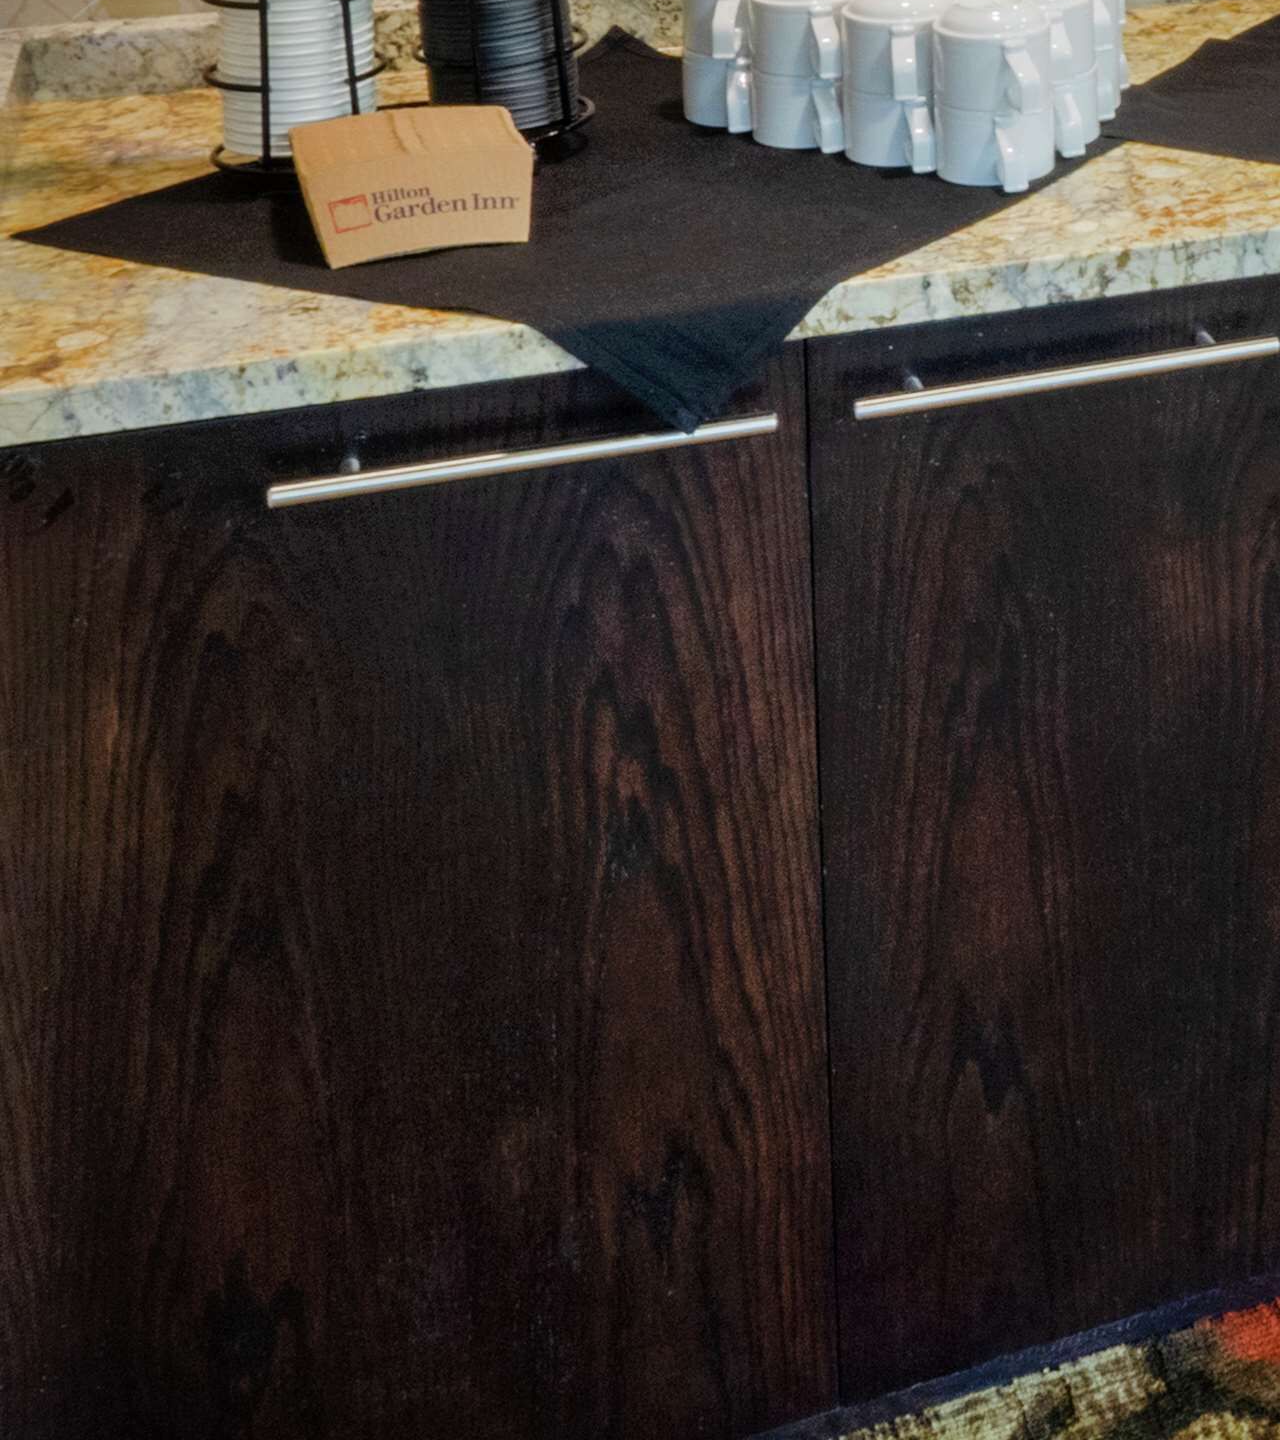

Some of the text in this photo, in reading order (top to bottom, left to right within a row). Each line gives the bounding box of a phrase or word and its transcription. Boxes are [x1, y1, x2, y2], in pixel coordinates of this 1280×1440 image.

[371, 186, 431, 206] Hilton
[374, 192, 516, 224] Garden Inn
